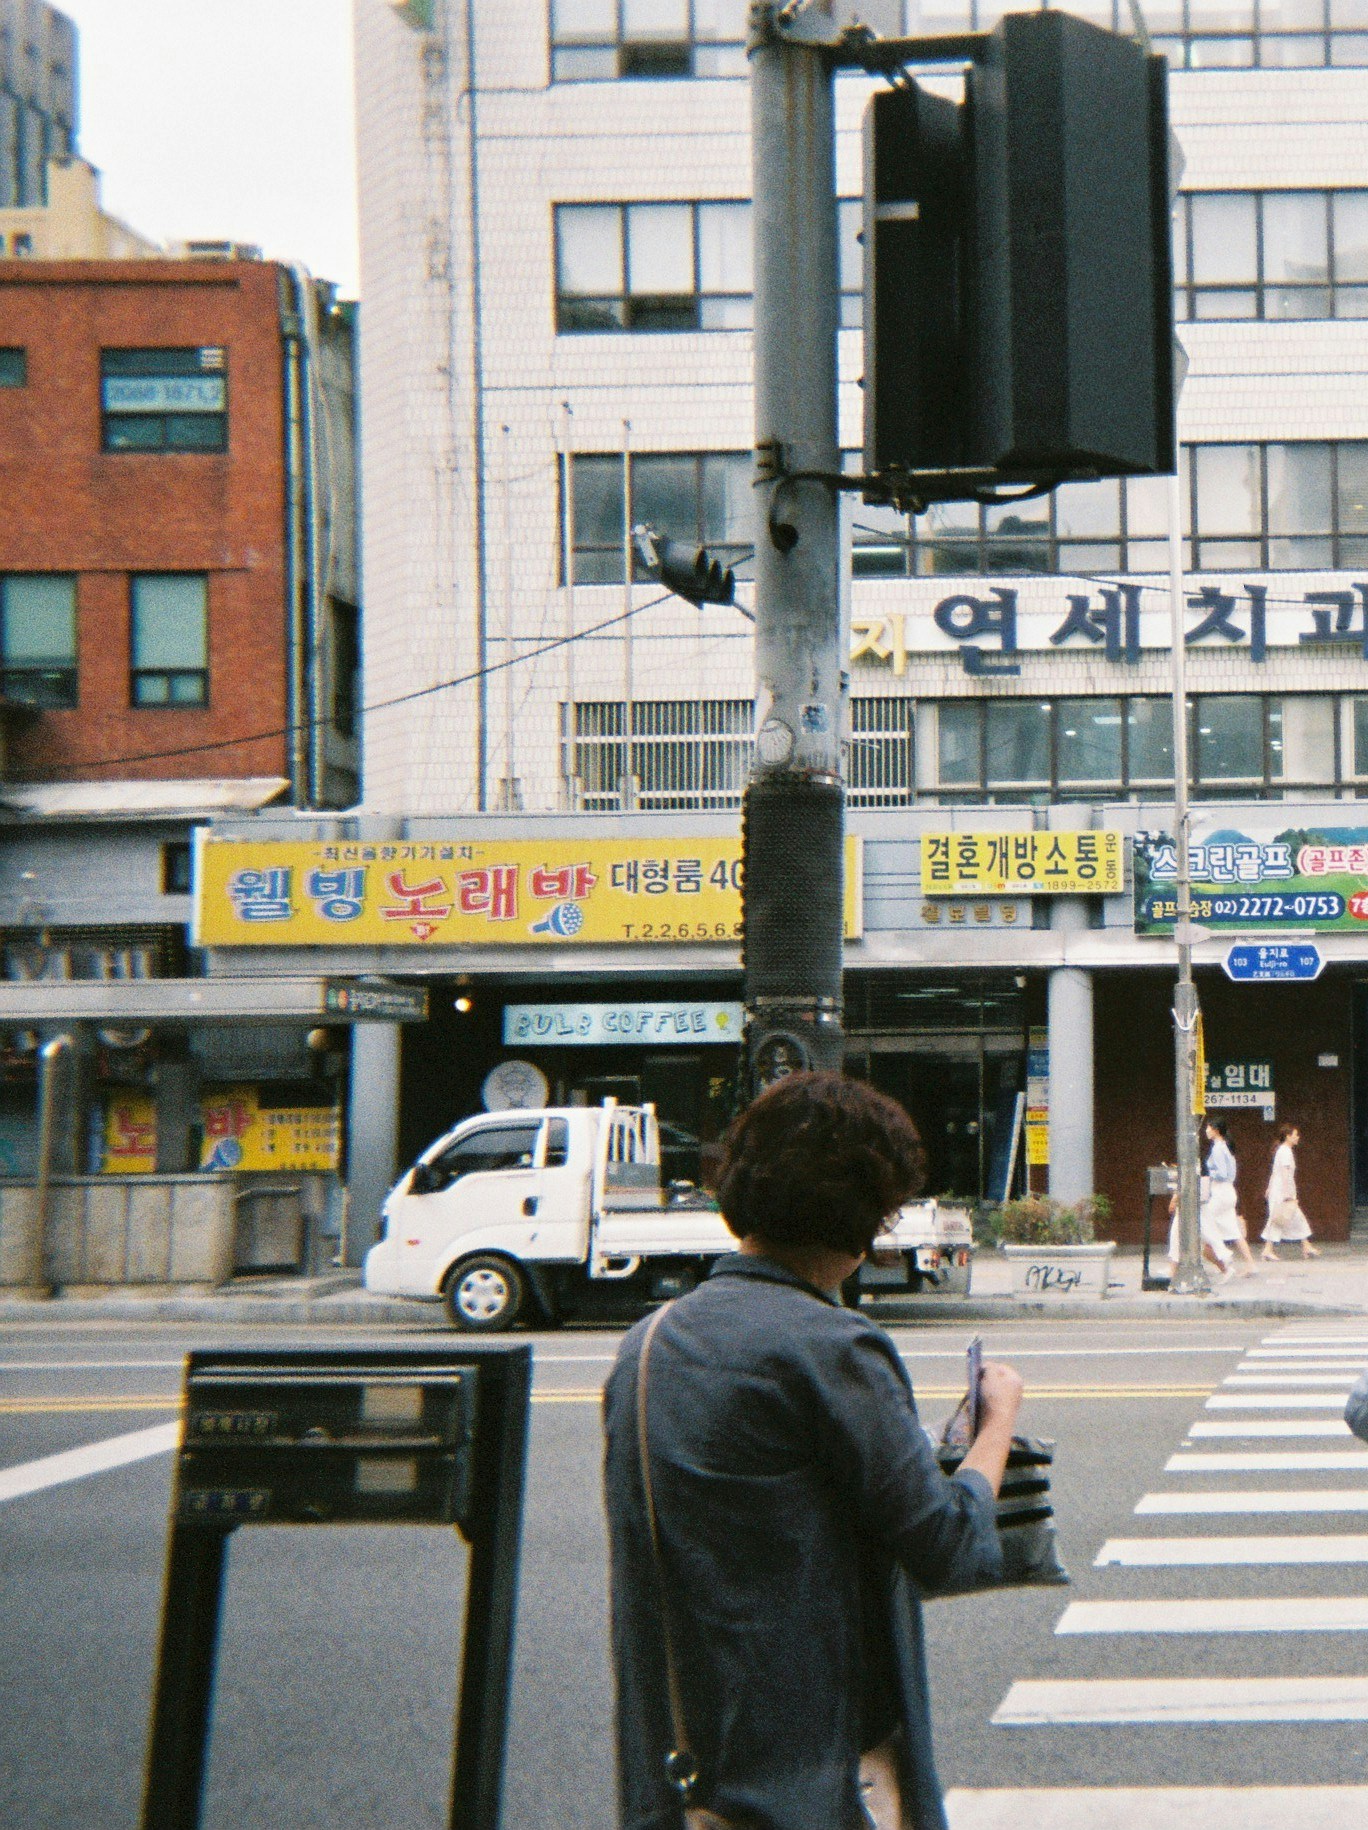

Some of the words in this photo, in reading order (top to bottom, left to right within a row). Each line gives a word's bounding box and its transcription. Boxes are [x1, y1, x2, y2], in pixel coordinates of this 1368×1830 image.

[1152, 843, 1293, 884] 스크린골프
[1046, 880, 1119, 891] 1899-2572
[1152, 901, 1213, 919] 골프습장
[1259, 947, 1289, 960] 을지로
[1233, 958, 1248, 967] 103
[1300, 957, 1315, 966] 107
[601, 1010, 708, 1034] COFFEE
[1224, 1064, 1270, 1087] 임대
